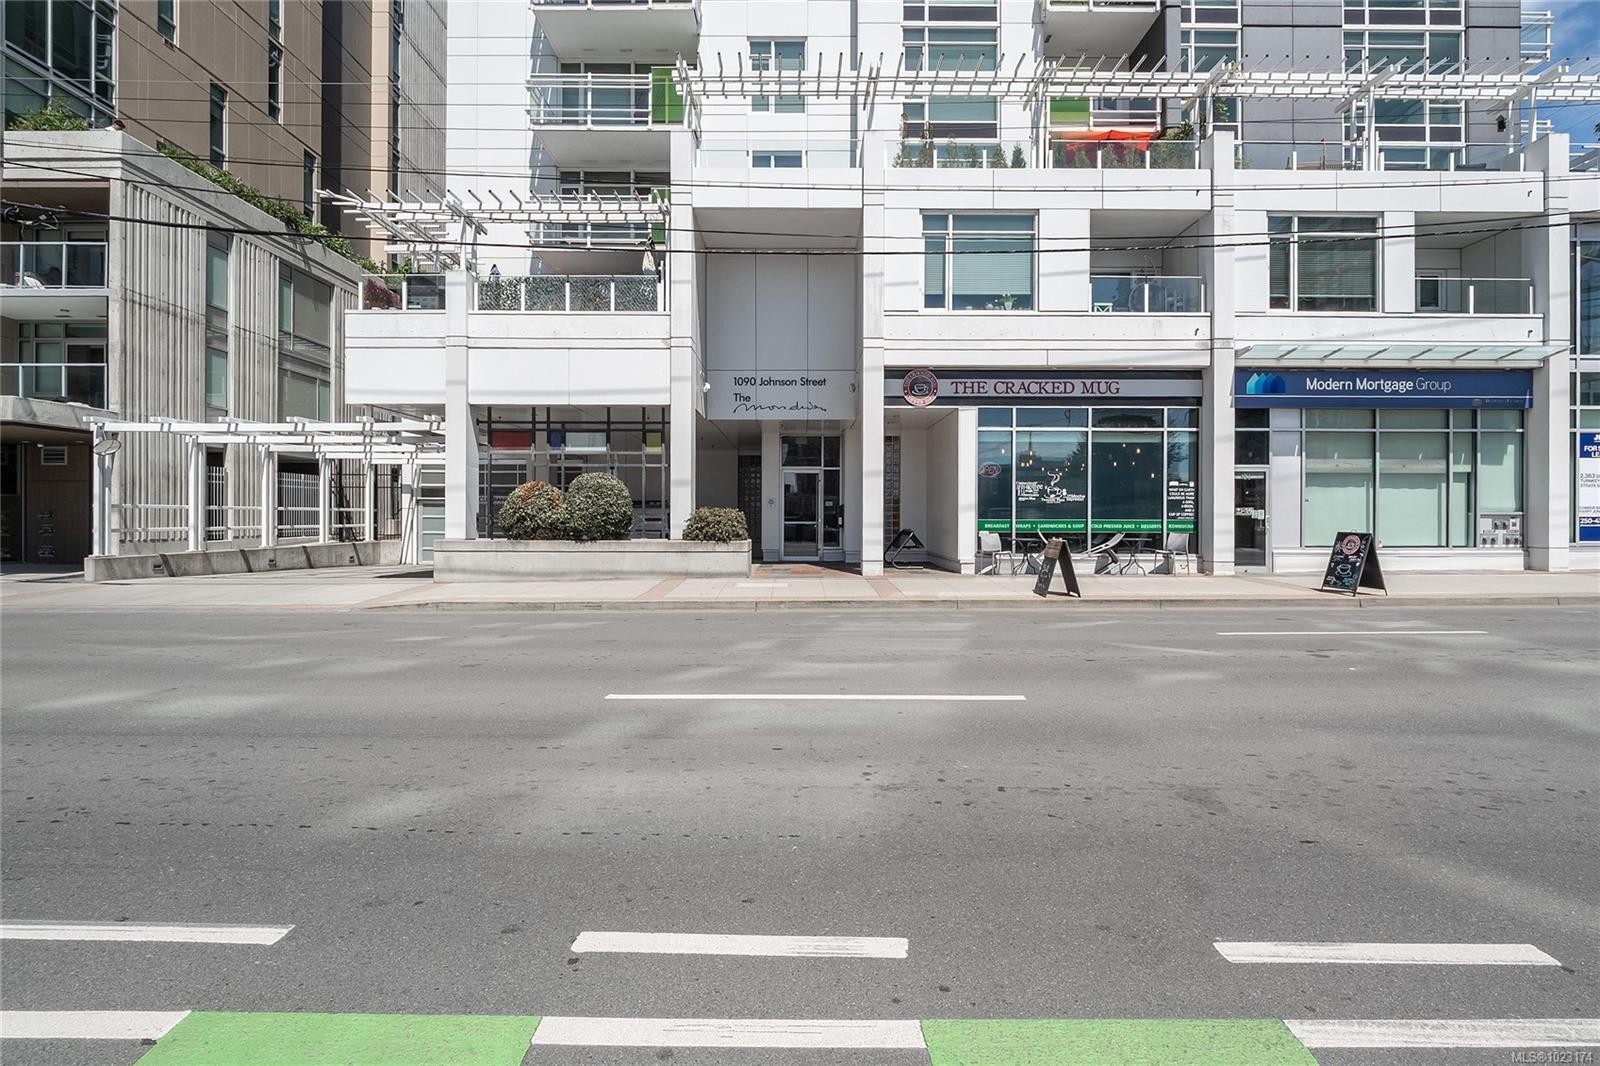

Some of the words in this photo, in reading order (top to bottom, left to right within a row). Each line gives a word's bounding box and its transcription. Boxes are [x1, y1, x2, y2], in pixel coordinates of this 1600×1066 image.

[733, 376, 757, 387] 1090
[758, 376, 798, 387] Johnson
[800, 376, 827, 387] Street
[951, 380, 989, 395] THE
[993, 380, 1075, 395] CRACKED
[1081, 380, 1121, 395] MUG
[1305, 377, 1353, 391] Modern
[1356, 377, 1414, 393] Mortgage
[1415, 377, 1452, 392] Group
[733, 392, 751, 403] The
